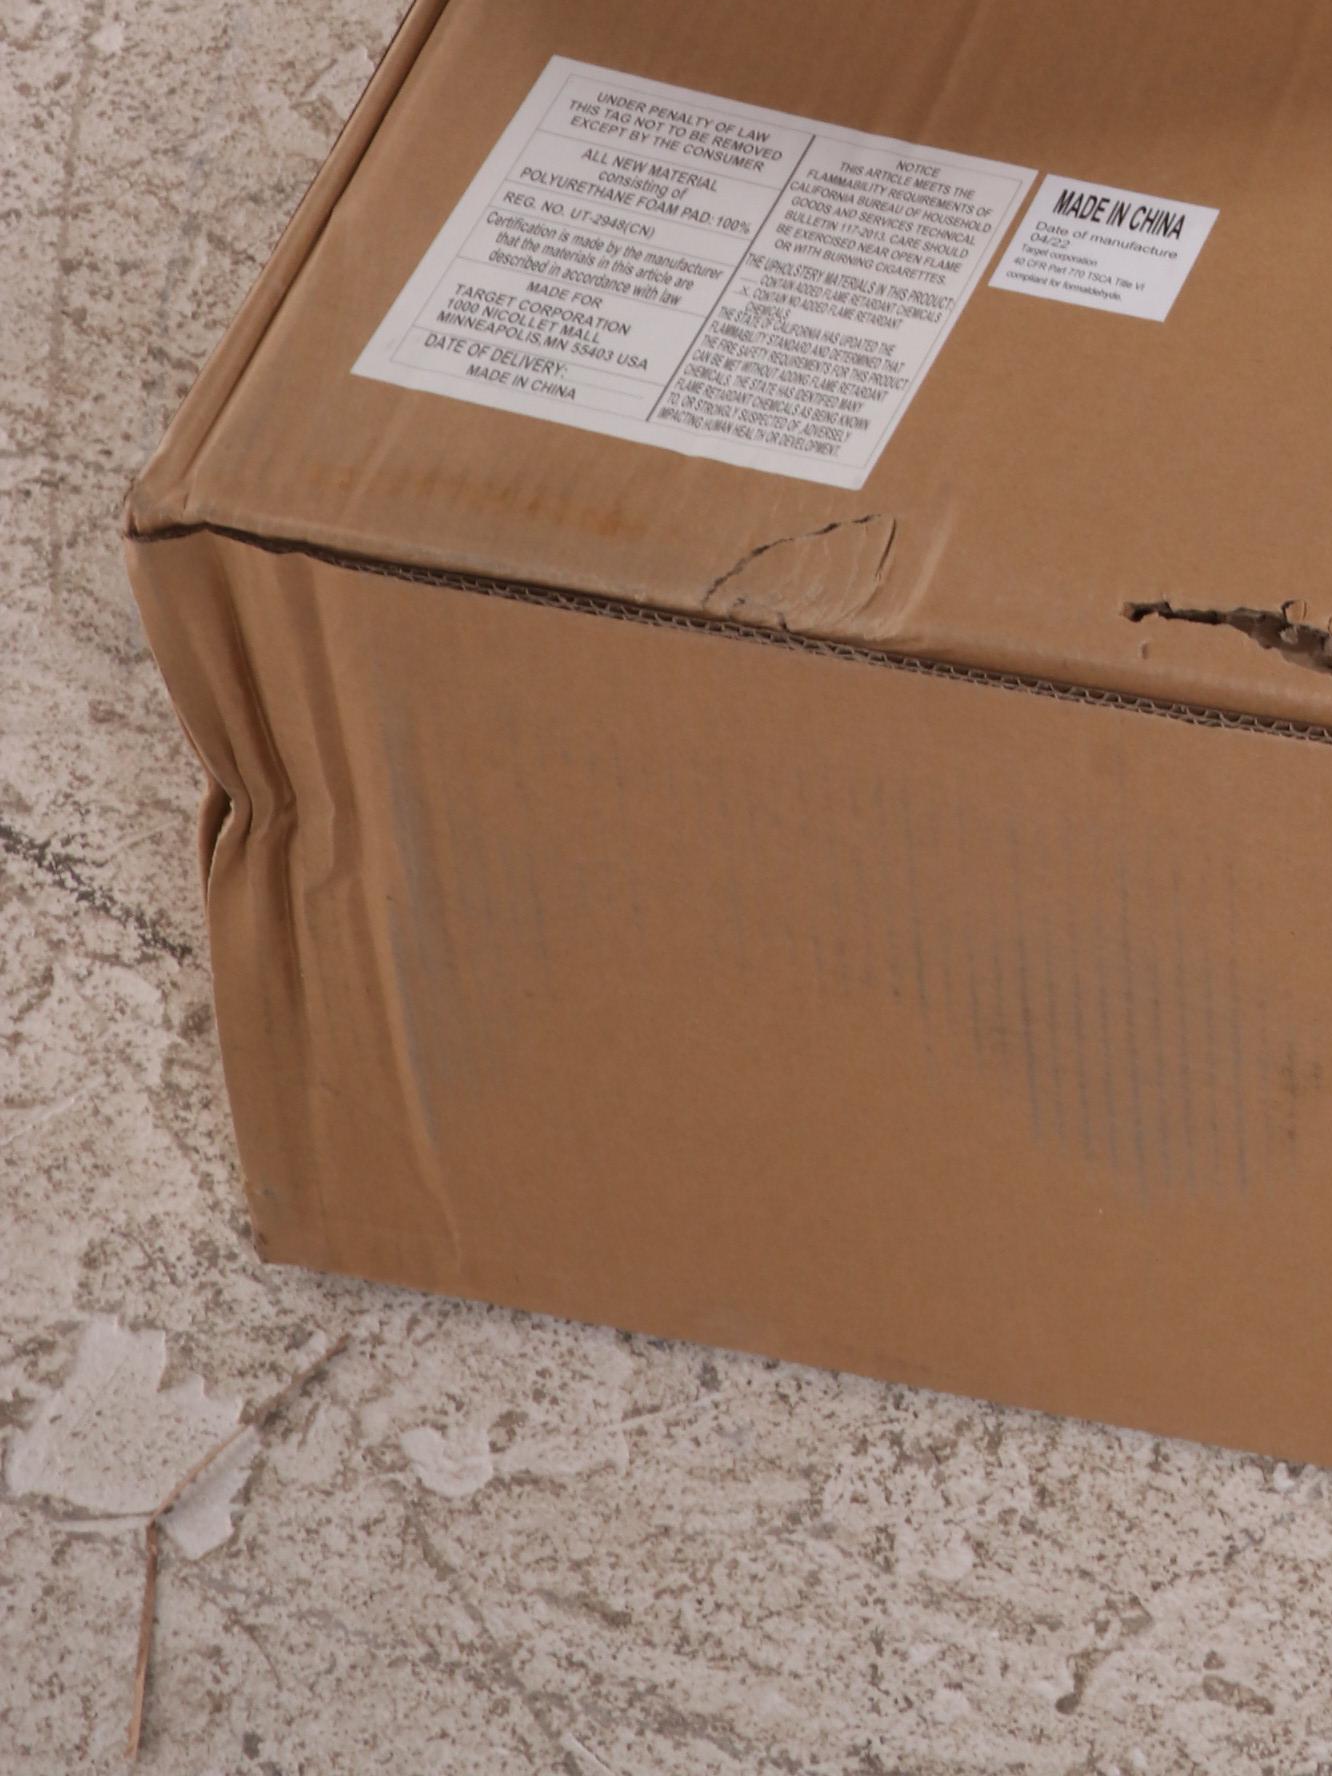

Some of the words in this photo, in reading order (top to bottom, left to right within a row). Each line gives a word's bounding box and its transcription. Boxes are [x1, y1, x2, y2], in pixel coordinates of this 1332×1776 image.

[569, 99, 601, 116] THIS
[604, 107, 633, 125] TAG
[633, 115, 666, 133] NOT
[667, 123, 688, 139] TO
[688, 129, 711, 144] BE
[710, 134, 783, 162] REMOVED
[596, 91, 648, 114] UNDER
[647, 104, 715, 130] PENALTY
[714, 121, 737, 135] OF
[736, 126, 771, 144] LAW
[569, 114, 629, 138] EXCEPT
[628, 129, 651, 144] BY
[652, 135, 681, 151] THE
[682, 143, 766, 173] CONSUMER
[519, 166, 636, 206] POLYURETHANE
[635, 195, 680, 216] FOAM
[580, 147, 608, 166] ALL
[611, 154, 649, 174] NEW
[647, 163, 718, 193] MATERIAL
[597, 169, 670, 199] consisting
[670, 187, 690, 201] of
[806, 168, 889, 196] FLAMMABILITY
[887, 187, 976, 215] REQUIREMENTS
[975, 206, 993, 218] OF
[839, 160, 865, 176] THIS
[864, 167, 914, 187] ARTICLE
[912, 177, 952, 196] MEETS
[953, 186, 976, 201] THE
[895, 159, 942, 179] NOTICE
[786, 178, 855, 205] CALIFORNIA
[856, 195, 905, 215] BUREAU
[904, 206, 922, 218] OF
[921, 209, 993, 234] HOUSEHOLD
[790, 195, 833, 216] GOODS
[832, 206, 858, 219] AND
[857, 211, 915, 233] SERVICES
[916, 223, 976, 247] TECHNICAL
[1051, 187, 1112, 225] MADE
[1104, 199, 1133, 229] IN
[1128, 204, 1187, 241] CHINA
[486, 210, 558, 239] Certification
[557, 227, 571, 243] is
[572, 234, 605, 252] made
[605, 239, 623, 258] by
[622, 245, 644, 261] the
[643, 252, 725, 280] manufacturer
[773, 238, 793, 253] OR
[793, 243, 823, 258] WITH
[821, 249, 875, 270] BURNING
[775, 222, 794, 237] BE
[792, 227, 857, 250] EXERCISED
[856, 241, 891, 259] NEAR
[890, 249, 923, 265] OPEN
[922, 255, 962, 273] FLAME
[784, 209, 839, 232] BULLETIN
[888, 233, 922, 250] CARE
[921, 240, 970, 259] SHOULD
[1021, 243, 1050, 257] Target
[1048, 251, 1099, 267] corporation
[1034, 220, 1070, 237] Date
[1072, 230, 1089, 240] of
[1089, 234, 1179, 260] manufacture
[488, 248, 551, 274] described
[547, 262, 562, 277] in
[561, 267, 632, 294] accordance
[632, 284, 659, 300] with
[659, 288, 682, 306] law
[495, 231, 521, 248] that
[520, 236, 541, 254] the
[541, 244, 596, 267] materials
[596, 255, 614, 270] in
[610, 259, 635, 276] this
[634, 267, 673, 286] article
[673, 277, 695, 291] are
[455, 282, 518, 308] TARGET
[515, 298, 632, 337] CORPORATION
[525, 280, 571, 301] MADE
[570, 291, 604, 310] FOR
[423, 332, 468, 355] DATE
[466, 342, 492, 359] OF
[447, 297, 481, 315] 1000
[481, 305, 560, 334] NICOLLET
[559, 323, 600, 345] MALL
[570, 341, 615, 363] 55403
[616, 352, 649, 372] USA
[466, 363, 512, 385] MADE
[511, 373, 530, 390] IN
[530, 378, 577, 401] CHINA
